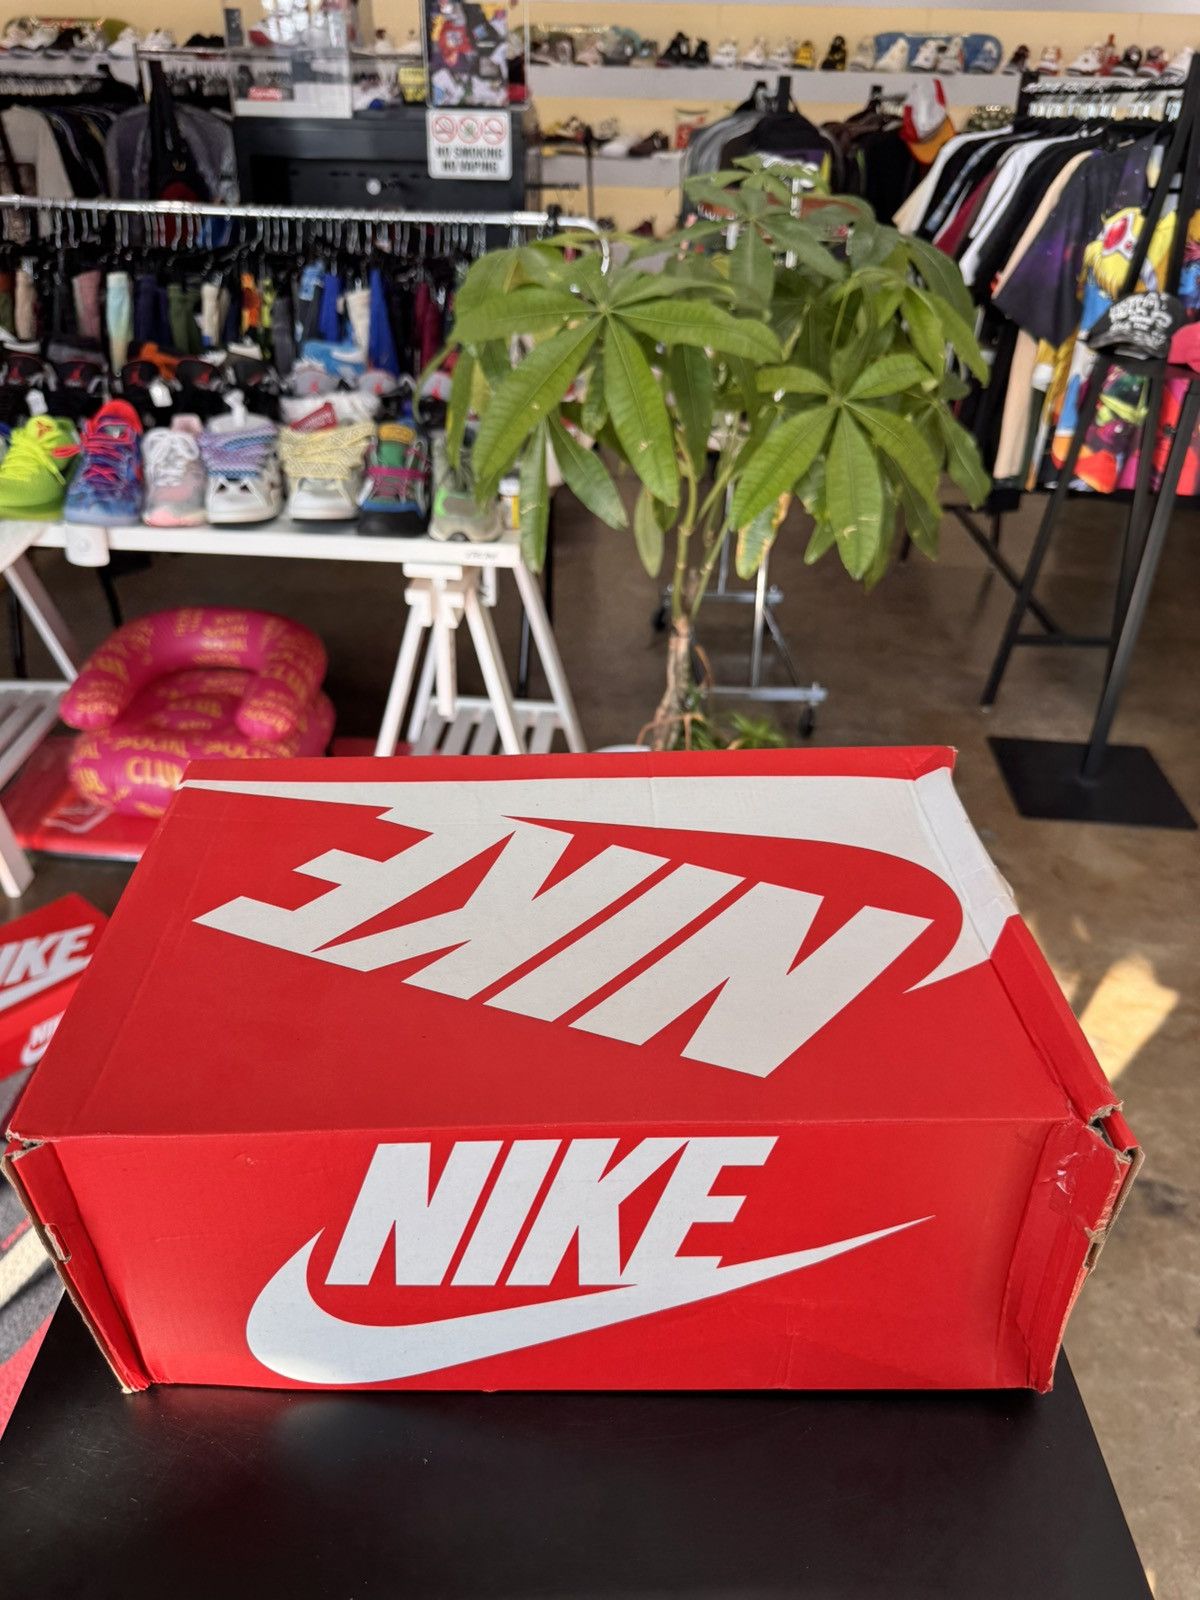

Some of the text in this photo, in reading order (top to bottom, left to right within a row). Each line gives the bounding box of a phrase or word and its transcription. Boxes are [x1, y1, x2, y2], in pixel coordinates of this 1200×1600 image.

[0, 923, 96, 987] IKE
[192, 805, 934, 1078] NIKE
[324, 1136, 780, 1287] NIKE
